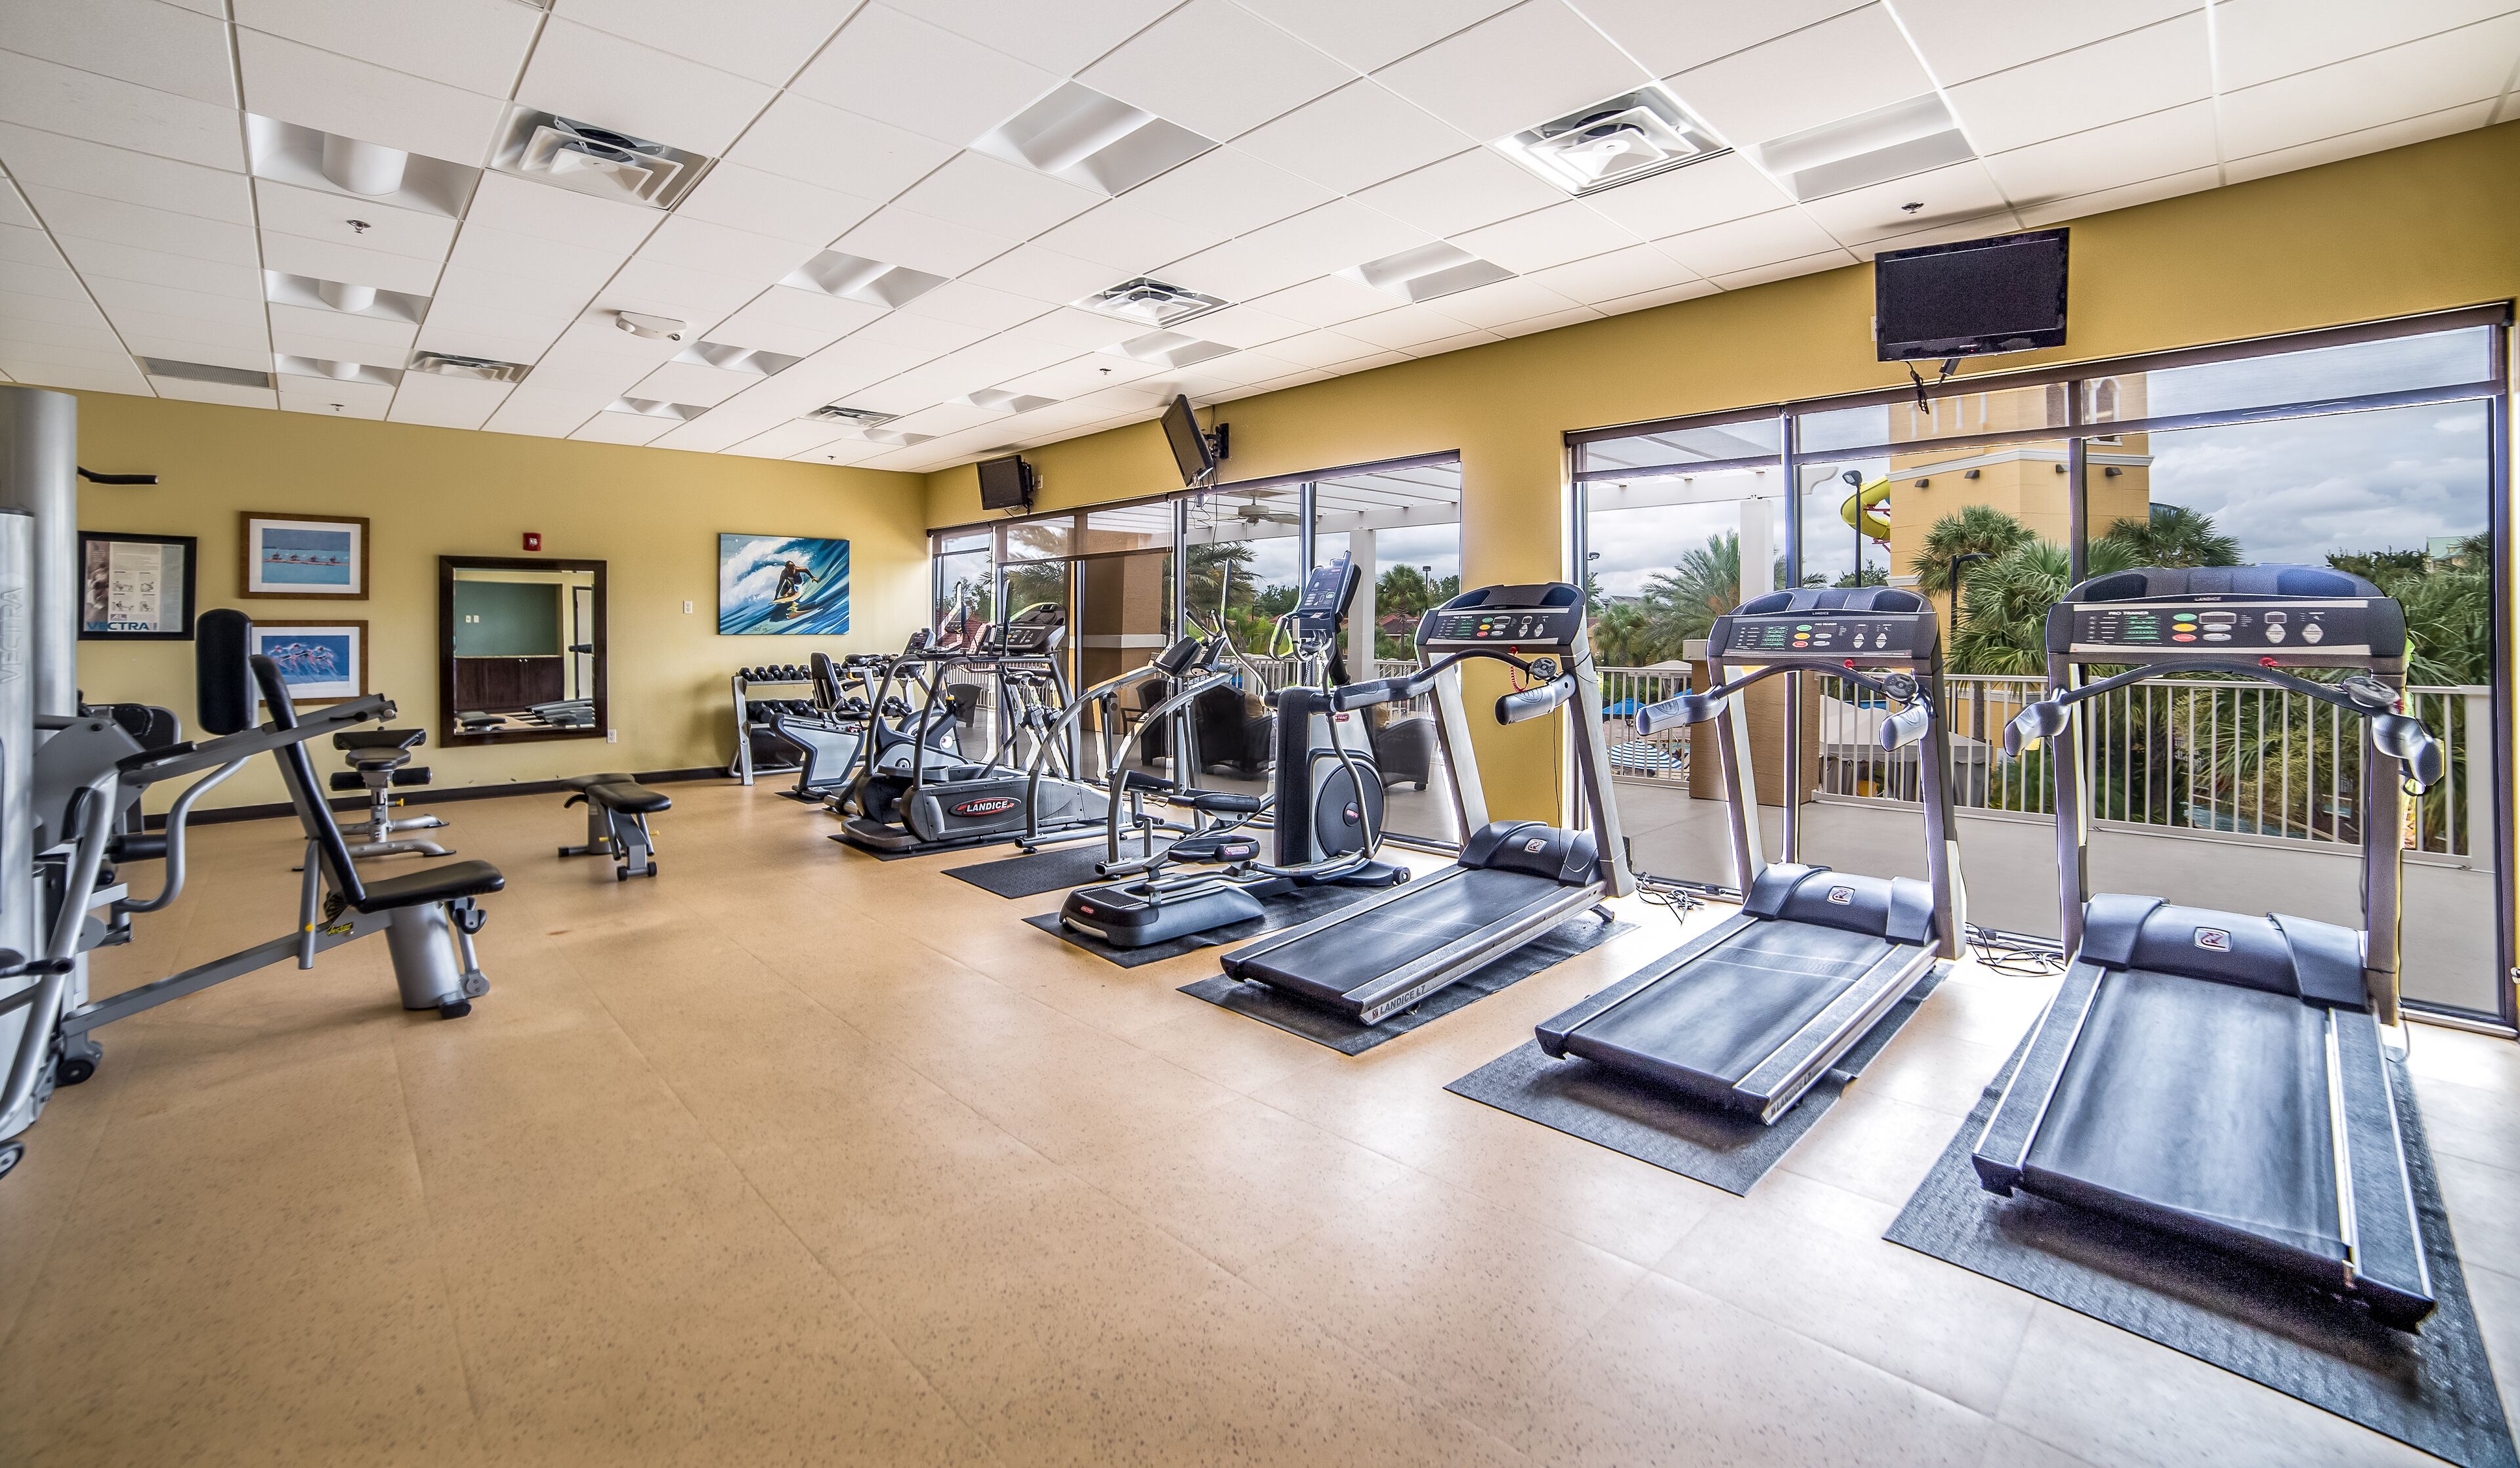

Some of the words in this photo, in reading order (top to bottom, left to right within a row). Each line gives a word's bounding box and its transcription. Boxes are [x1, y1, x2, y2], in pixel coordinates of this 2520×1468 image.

[0, 587, 23, 684] VECTRA
[86, 622, 150, 631] VECTRA
[966, 801, 1009, 812] LANDICE
[1379, 990, 1415, 1015] LANDICE
[1416, 984, 1426, 997] L7
